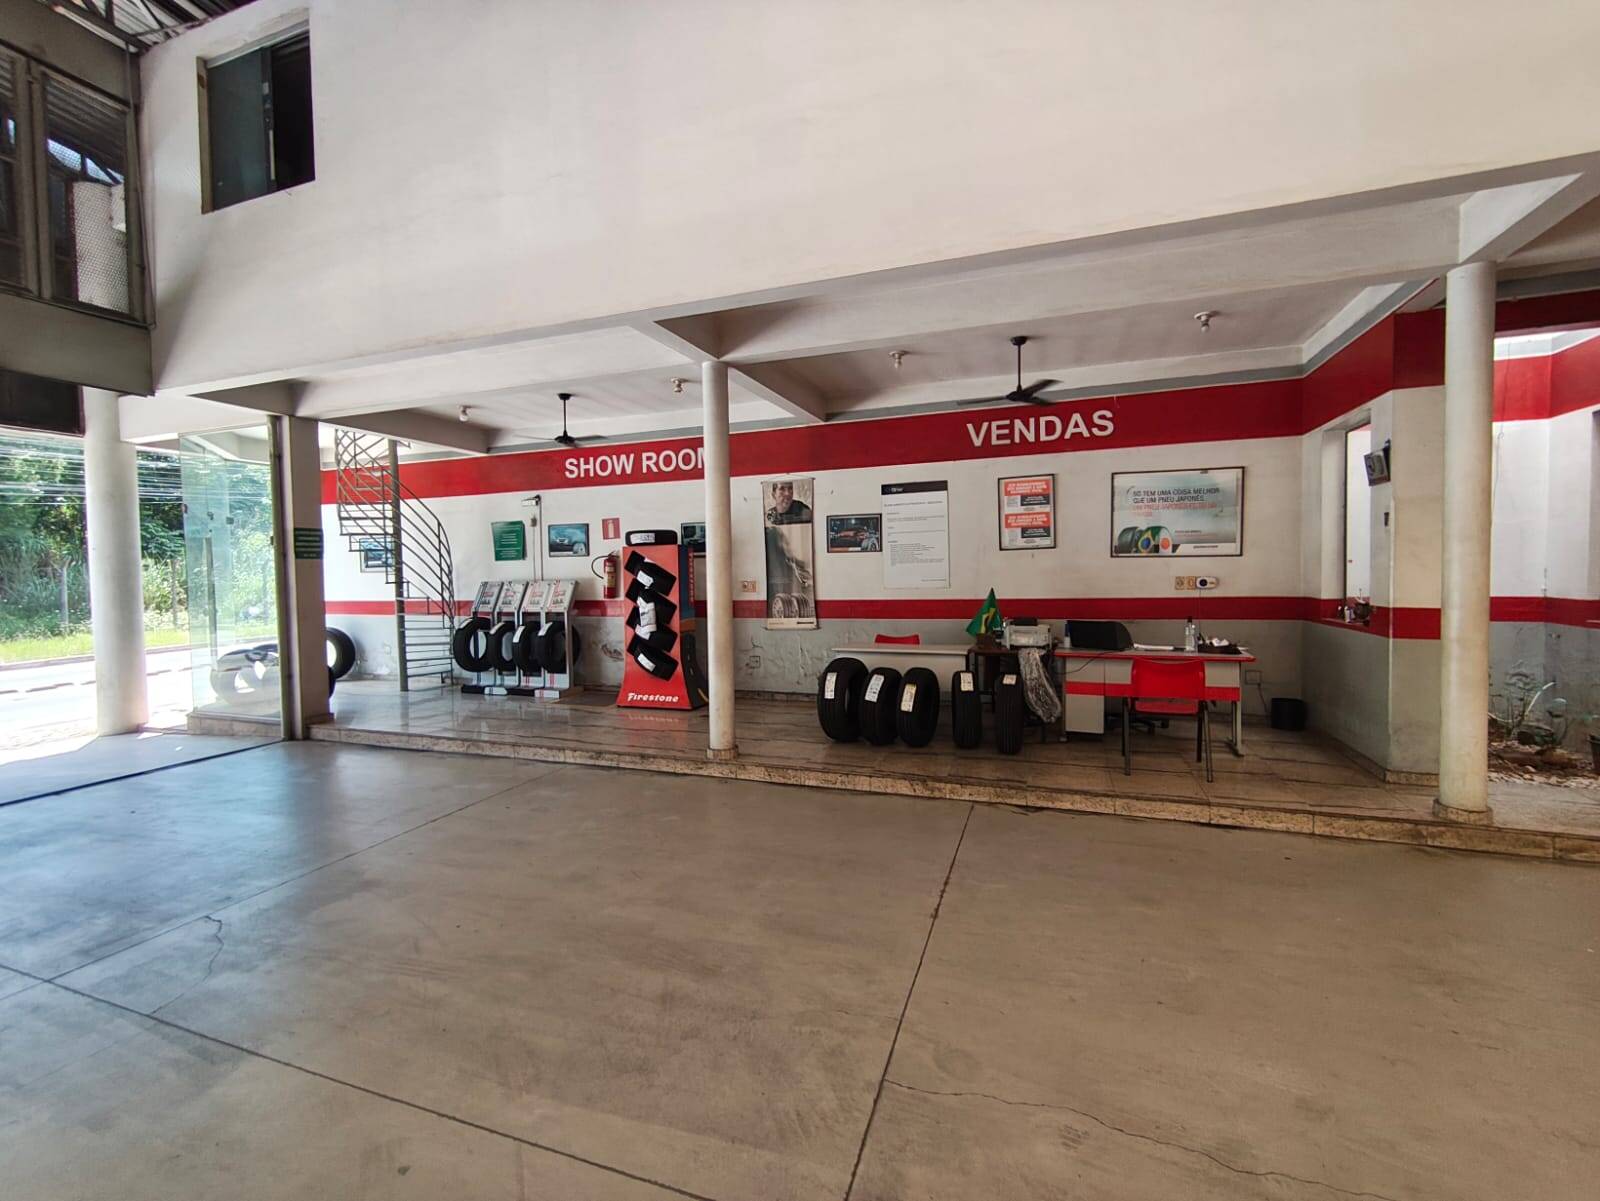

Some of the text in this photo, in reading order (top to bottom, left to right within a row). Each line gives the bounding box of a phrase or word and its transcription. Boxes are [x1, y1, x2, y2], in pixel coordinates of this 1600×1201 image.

[966, 409, 1114, 447] VENDAS
[564, 453, 635, 479] SHOW
[1193, 487, 1220, 495] MELHOR
[627, 692, 679, 703] Firestone
